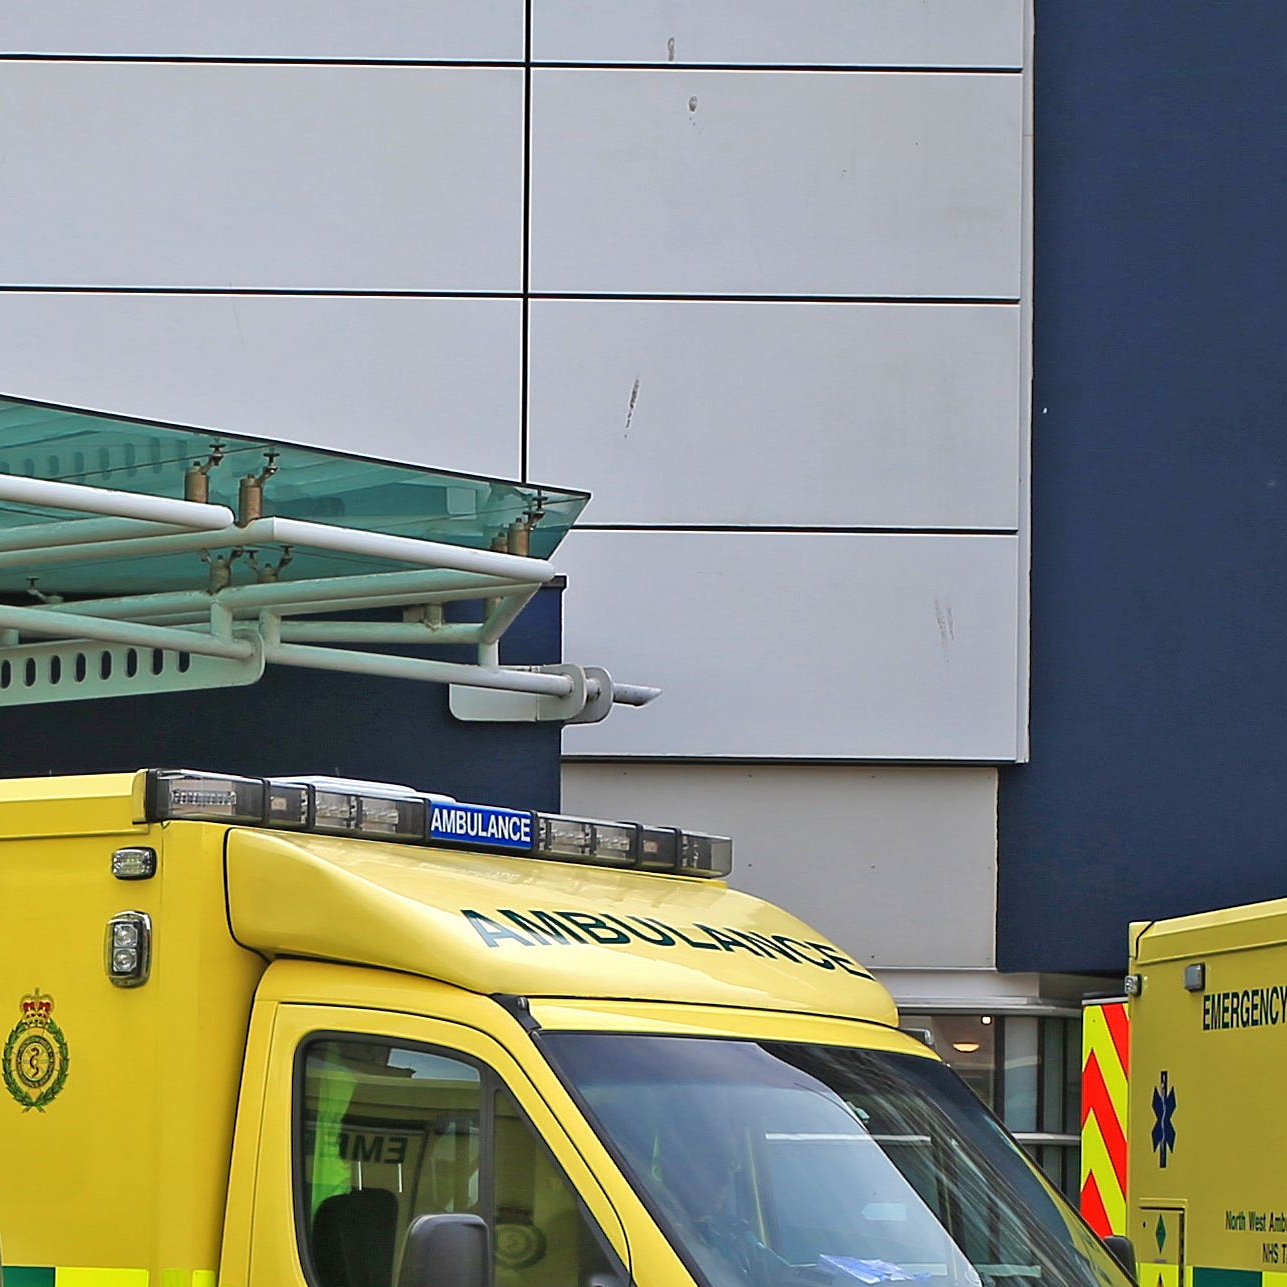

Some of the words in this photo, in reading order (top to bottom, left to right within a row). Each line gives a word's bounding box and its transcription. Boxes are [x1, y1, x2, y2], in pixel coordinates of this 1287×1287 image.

[431, 808, 531, 842] AMBULANCE
[460, 909, 875, 981] AMBULANCE
[1225, 1210, 1246, 1231] North
[1249, 1211, 1266, 1232] West
[1262, 1243, 1279, 1264] NHS
